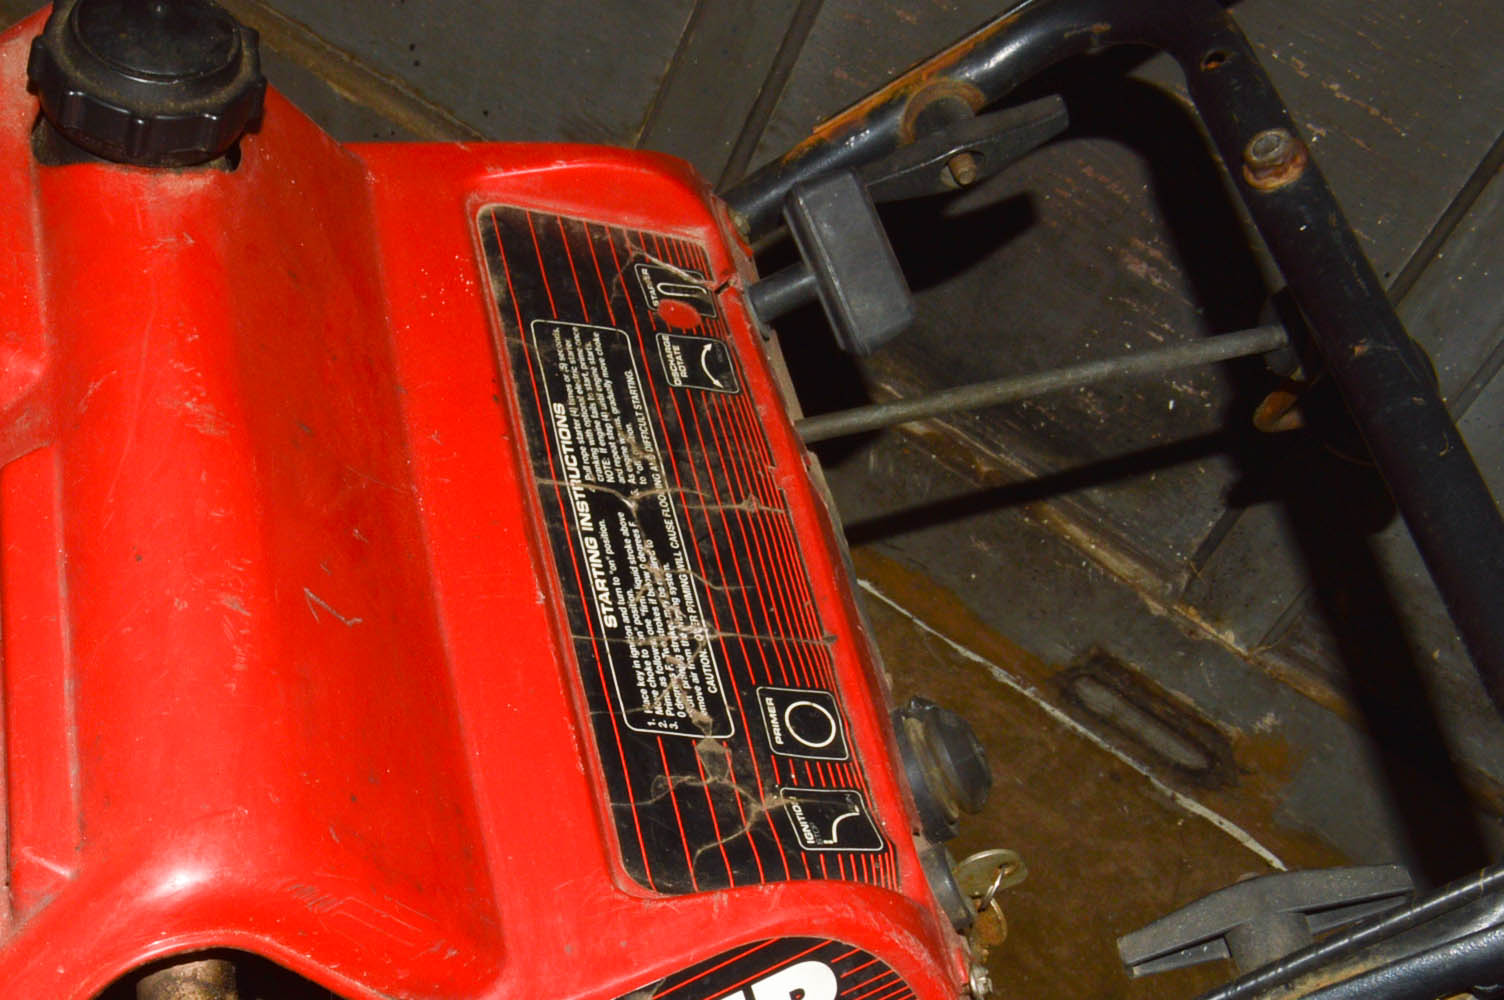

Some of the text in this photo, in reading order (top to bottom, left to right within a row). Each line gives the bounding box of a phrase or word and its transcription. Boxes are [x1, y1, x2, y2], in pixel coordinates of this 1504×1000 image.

[572, 326, 581, 346] once
[592, 332, 603, 355] choke
[576, 347, 588, 370] prime
[599, 357, 609, 377] move
[662, 335, 682, 387] DISCHARGE
[672, 345, 688, 378] ROTATE
[563, 374, 570, 382] or
[590, 366, 602, 391] engine
[565, 384, 575, 405] times
[603, 379, 620, 414] gradually
[576, 396, 591, 427] optional
[588, 402, 599, 418] fails
[573, 418, 585, 444] starter
[585, 429, 595, 445] with
[594, 420, 606, 446] engine
[605, 423, 615, 439] step
[635, 411, 653, 451] DIFFICULT
[580, 446, 589, 464] rope
[590, 447, 604, 482] cranking
[608, 441, 621, 466] repeat
[615, 468, 626, 483] and
[627, 473, 636, 483] As
[639, 476, 647, 484] to
[650, 473, 672, 517] FLOOING
[553, 402, 617, 627] STARTING INSTRUCTIONS
[617, 512, 630, 536] above
[599, 519, 614, 554] position.
[632, 529, 646, 562] degrees
[644, 539, 654, 547] to
[664, 519, 679, 548] CAUSE
[624, 538, 636, 564] stroke
[612, 576, 620, 585] to
[658, 586, 667, 597] be
[615, 587, 625, 605] turn
[635, 592, 650, 616] "firm
[679, 574, 696, 613] PRIMING
[618, 606, 630, 623] and
[626, 588, 643, 625] position.
[659, 599, 674, 618] my
[644, 618, 654, 635] one
[688, 614, 705, 641] OER
[641, 649, 649, 658] to
[635, 670, 645, 686] key
[644, 660, 657, 687] choke
[659, 676, 667, 687] as
[689, 671, 699, 683] air
[638, 687, 653, 713] Pace
[651, 689, 664, 715] Move
[659, 688, 675, 716] Prim
[666, 672, 685, 709] degrs
[691, 685, 709, 718] emove
[765, 697, 784, 745] PRIMER
